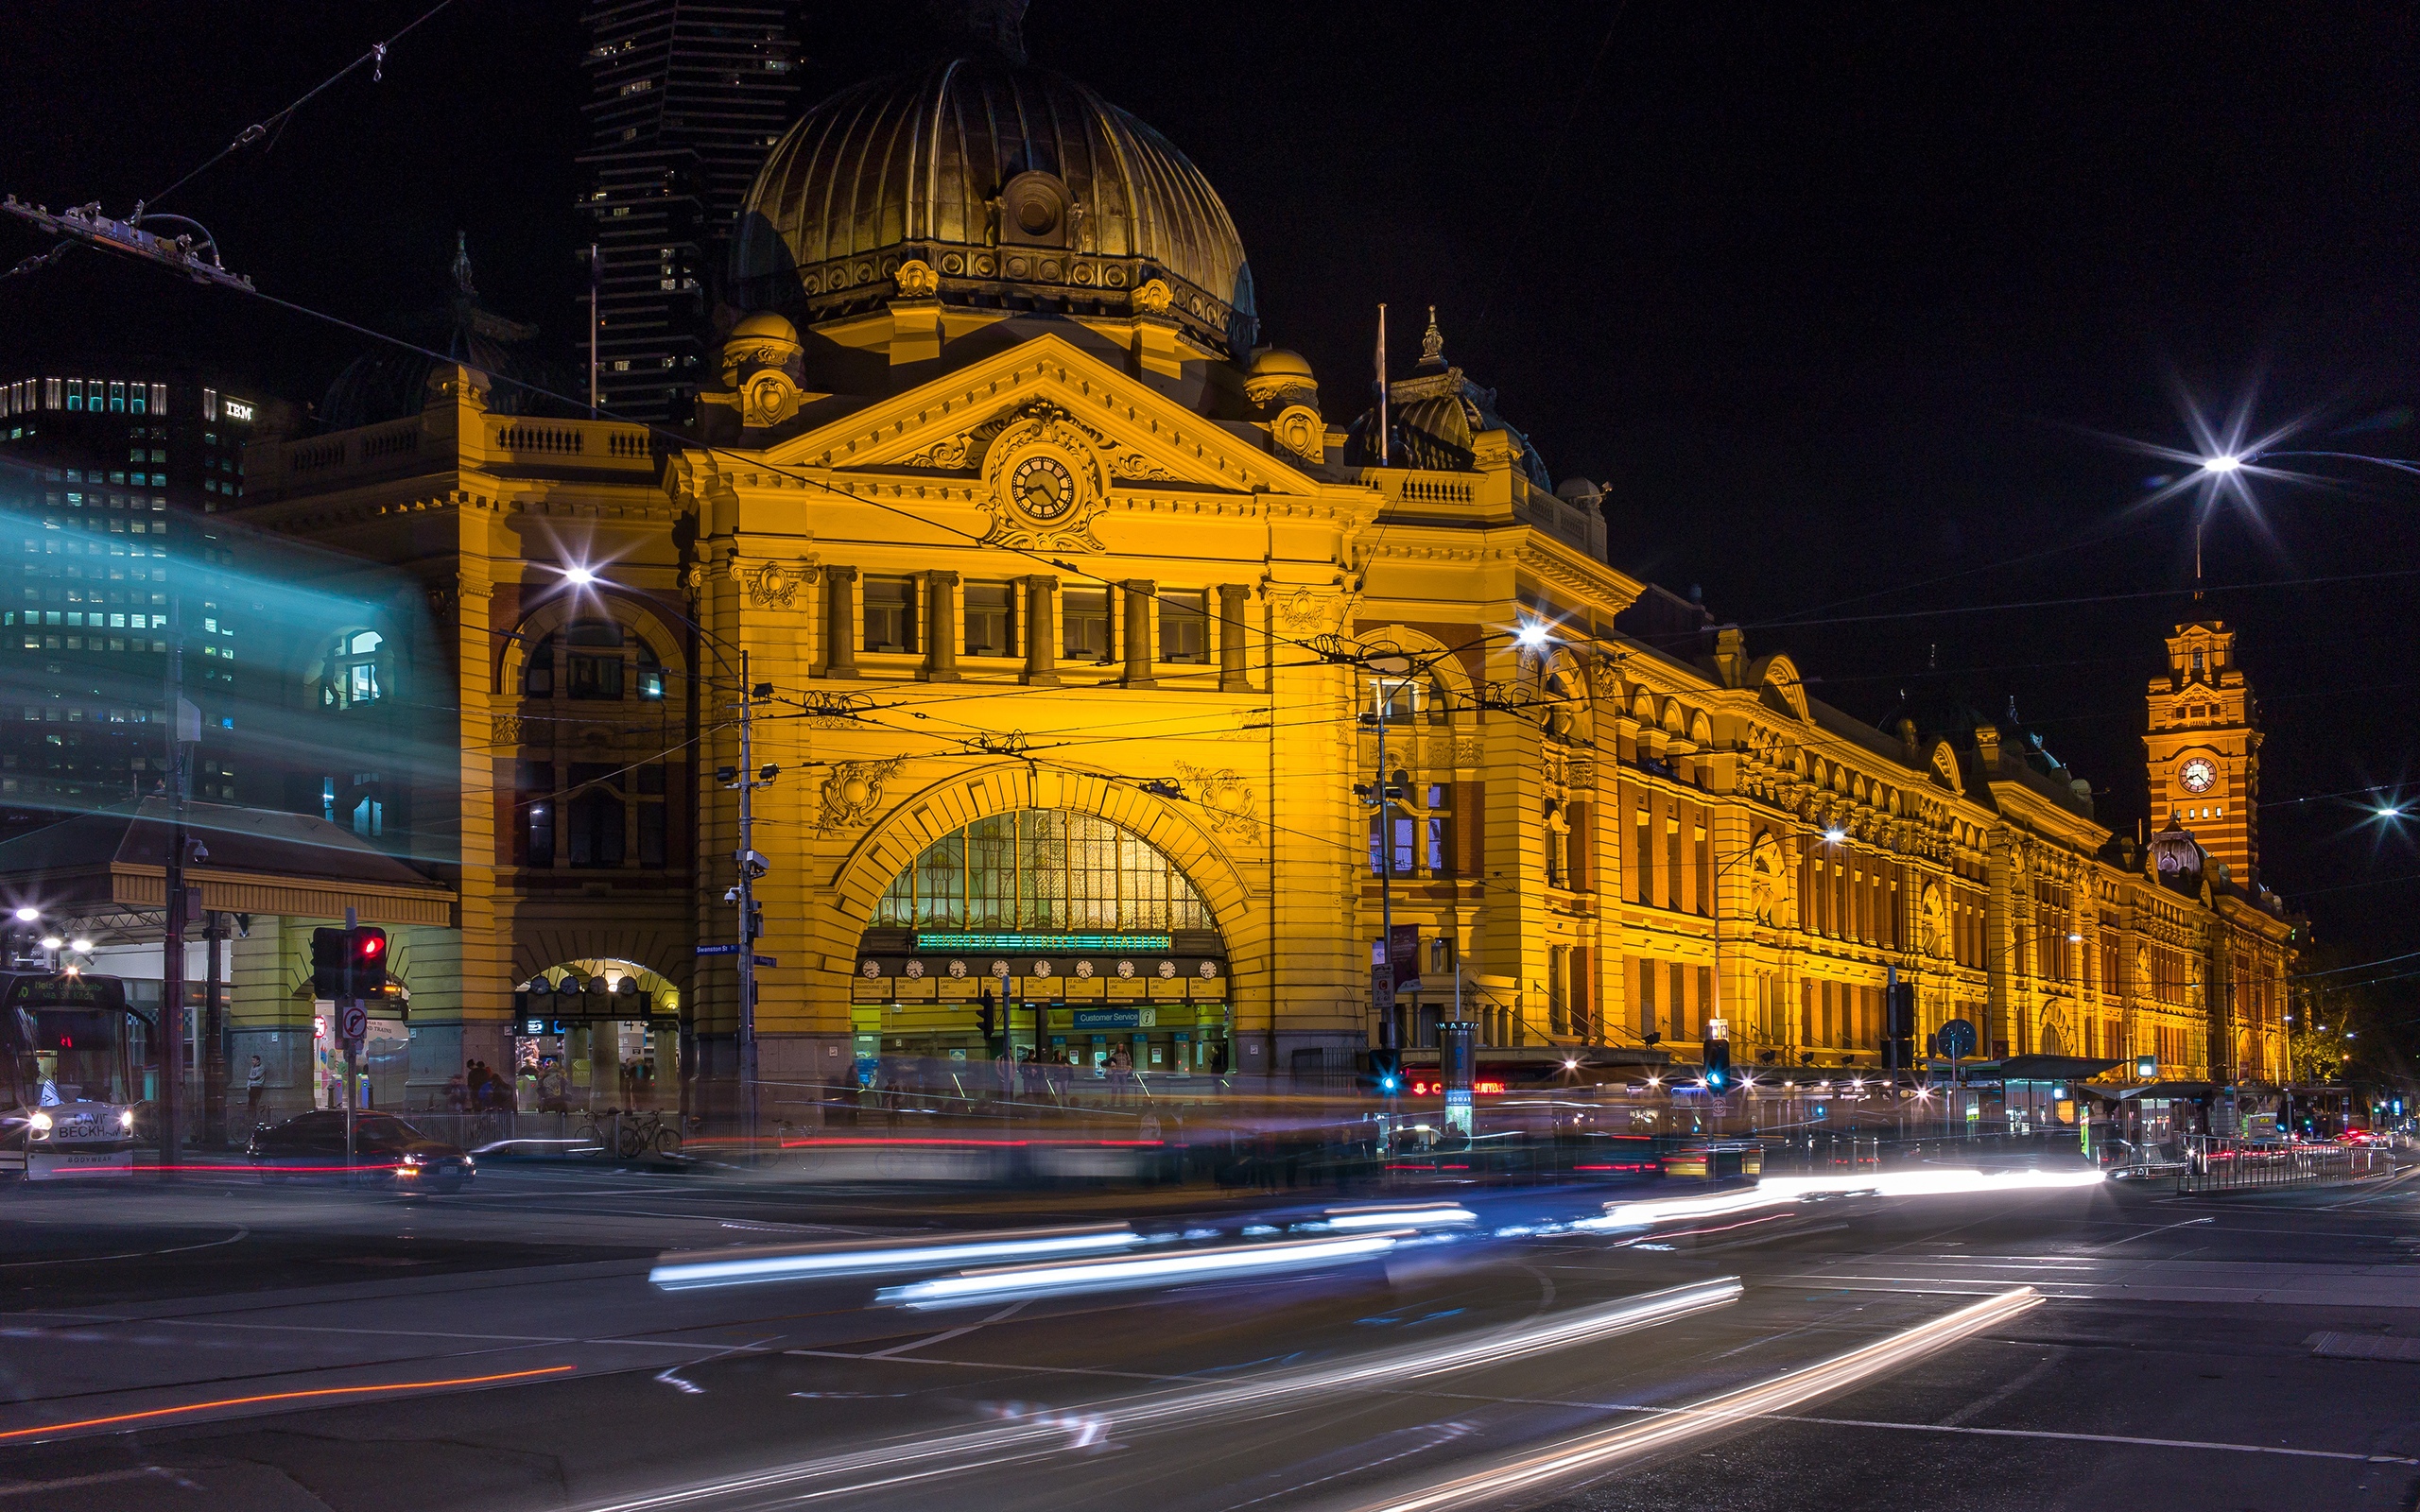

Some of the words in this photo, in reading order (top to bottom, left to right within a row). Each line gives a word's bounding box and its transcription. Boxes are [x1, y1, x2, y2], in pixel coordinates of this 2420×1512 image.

[226, 402, 253, 421] IBM
[917, 934, 997, 948] FLINDERS
[1021, 935, 1080, 949] STREET
[1101, 935, 1172, 949] STATION
[73, 991, 95, 1000] Kilda
[1080, 1014, 1113, 1022] Customer
[373, 1025, 392, 1034] TRAINS
